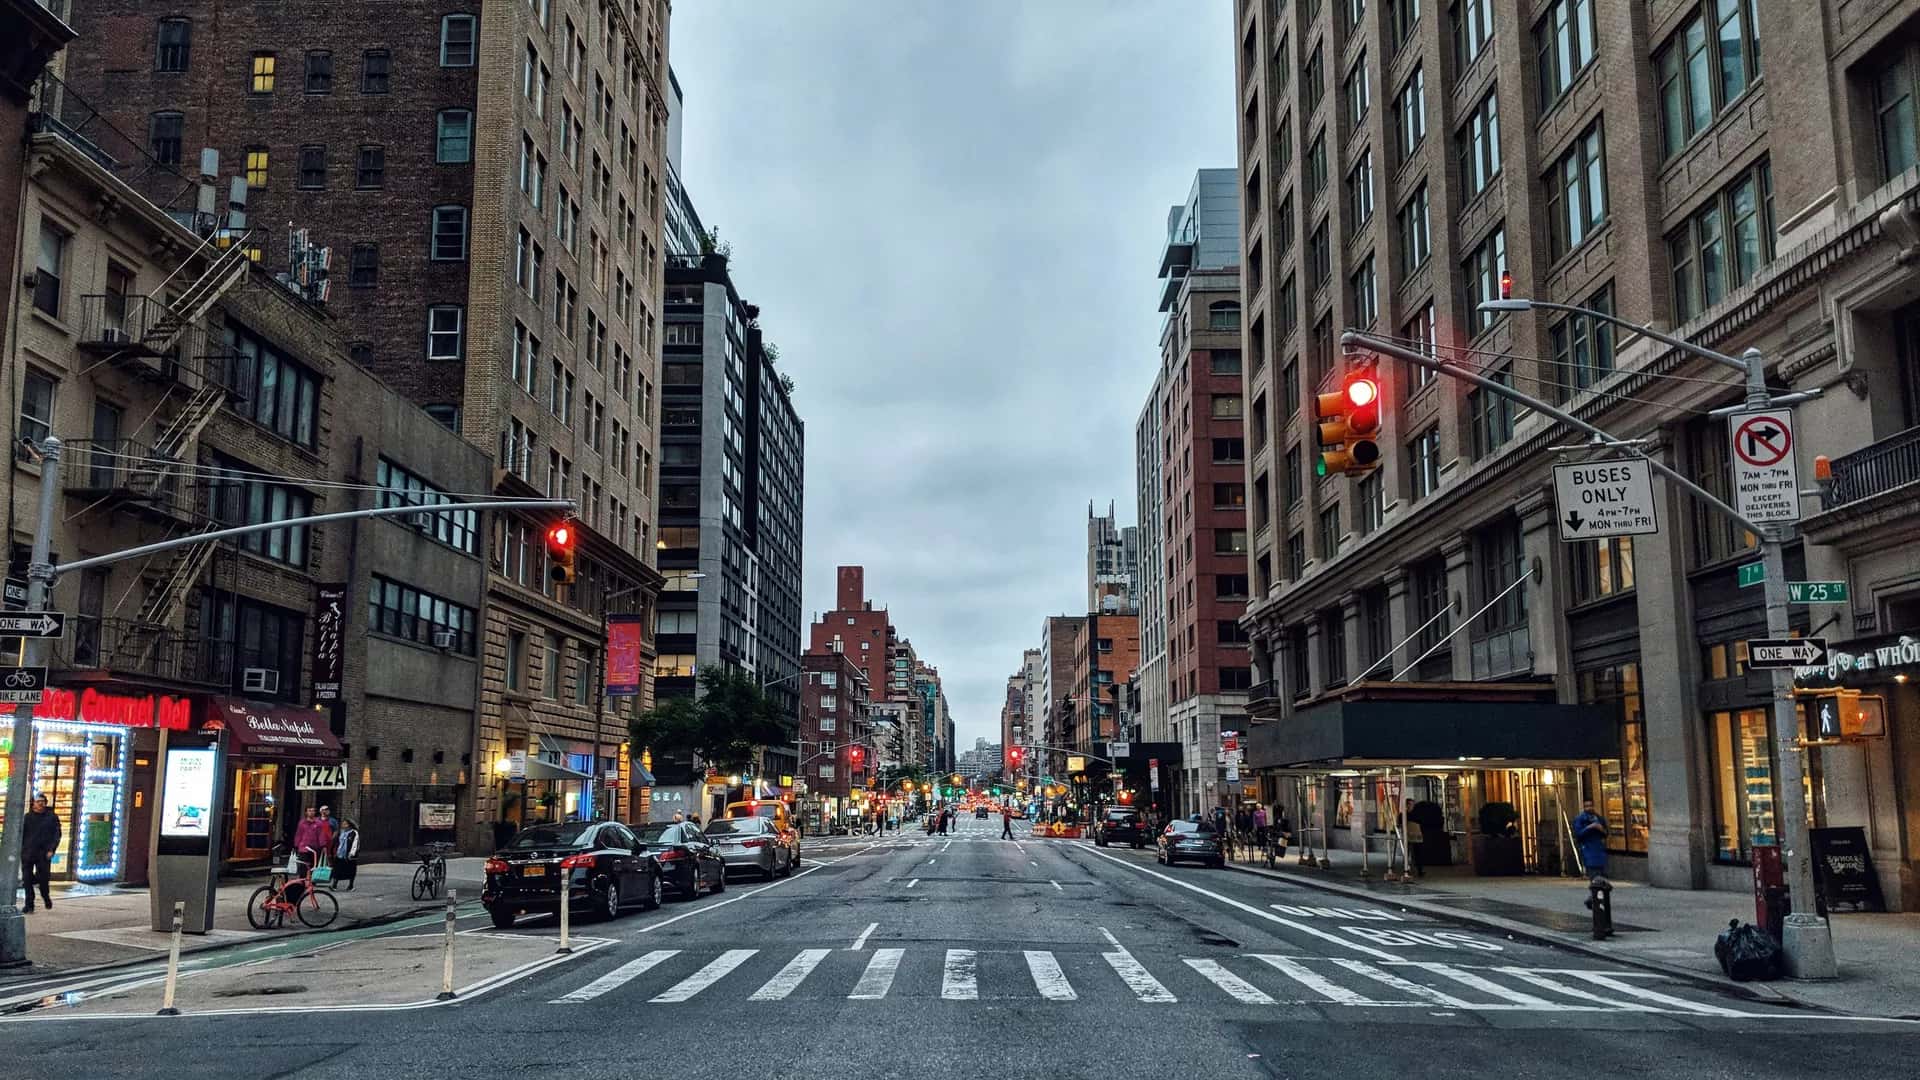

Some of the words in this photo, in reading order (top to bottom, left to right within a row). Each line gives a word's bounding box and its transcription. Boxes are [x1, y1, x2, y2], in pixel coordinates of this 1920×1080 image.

[1573, 467, 1631, 485] BUSES
[1743, 472, 1760, 480] 7AM
[1770, 469, 1789, 478] 7PM
[1740, 484, 1759, 492] MON
[1779, 480, 1793, 489] FRI
[1582, 487, 1627, 504] ONLY
[1753, 494, 1782, 502] EXCEPT
[1745, 502, 1791, 511] DELIVERIES
[1766, 510, 1791, 518] BLOCK
[1589, 520, 1611, 529] MON
[1614, 520, 1633, 528] THRU
[1635, 516, 1652, 526] FRI
[7, 585, 22, 596] ONE
[1790, 585, 1802, 600] W
[1808, 584, 1828, 600] 25
[0, 620, 21, 630] ONE
[30, 620, 53, 631] WAY
[1760, 648, 1782, 659] ONE
[1792, 647, 1816, 659] WAY
[1857, 652, 1871, 670] at
[20, 691, 41, 701] LANE
[80, 688, 154, 727] Gourmet
[246, 715, 280, 730] Bella
[280, 718, 315, 737] Napoli
[297, 766, 345, 787] PIZZA
[652, 792, 682, 801] SEA
[1270, 904, 1405, 921] ONLY
[1338, 926, 1504, 951] BUS
